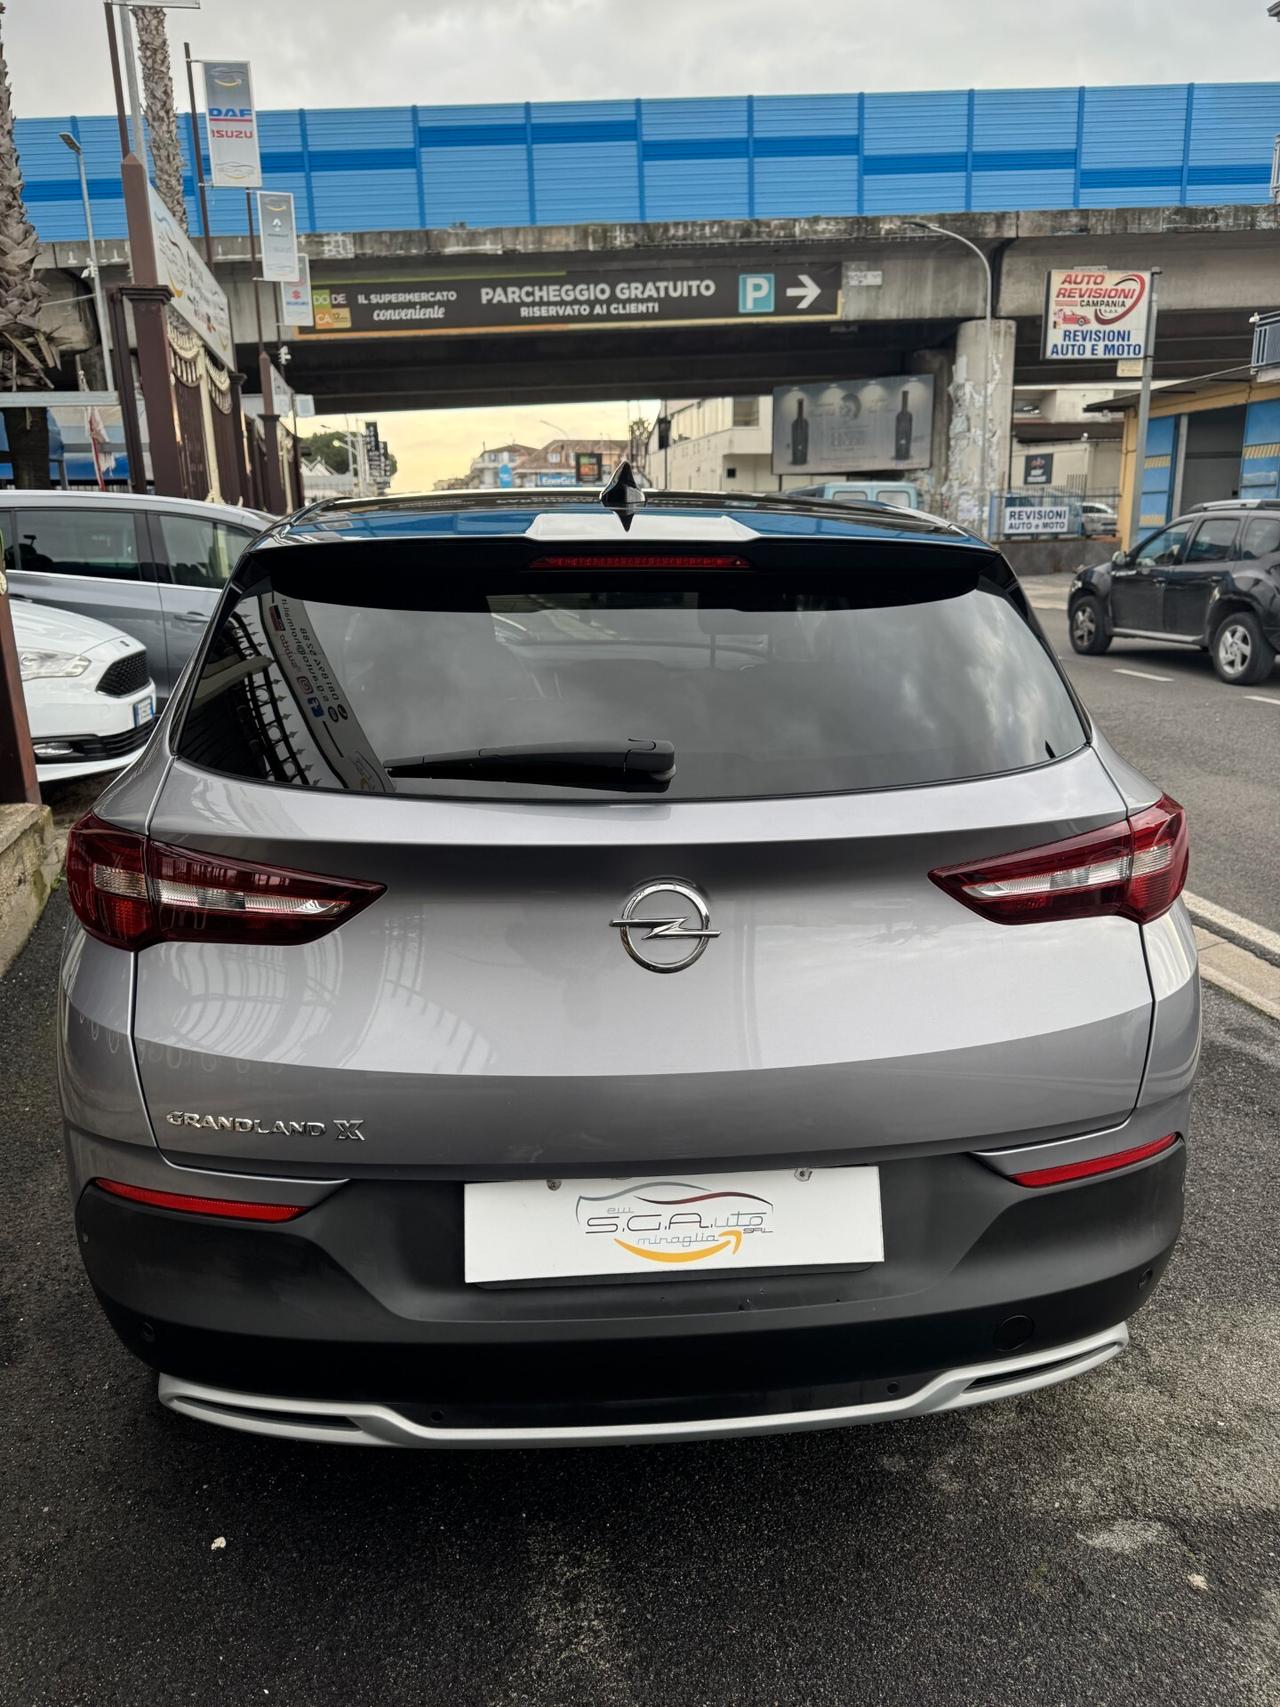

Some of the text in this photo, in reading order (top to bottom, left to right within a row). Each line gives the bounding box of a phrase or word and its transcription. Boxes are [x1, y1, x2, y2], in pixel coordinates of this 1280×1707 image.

[208, 108, 252, 117] DAF
[211, 129, 253, 139] ISUZU
[1061, 274, 1105, 285] AUTO
[357, 291, 457, 304] IL SUPERMERCATO
[481, 280, 716, 304] PARCHEGGIO GRATUITO
[1056, 288, 1136, 299] REVISIONI
[520, 302, 659, 318] RISERVATO AI CLIENTI
[1079, 300, 1126, 308] CAMPANIA
[373, 305, 445, 321] conveniente
[1063, 330, 1131, 342] REVISIONI
[1051, 344, 1142, 356] AUTO E MOTO
[1009, 510, 1067, 520] REVISIONI
[1008, 522, 1033, 530] AUTO
[1042, 521, 1065, 530] MOTO
[166, 1111, 365, 1140] GRANDLAND X
[637, 1232, 719, 1248] miraglia
